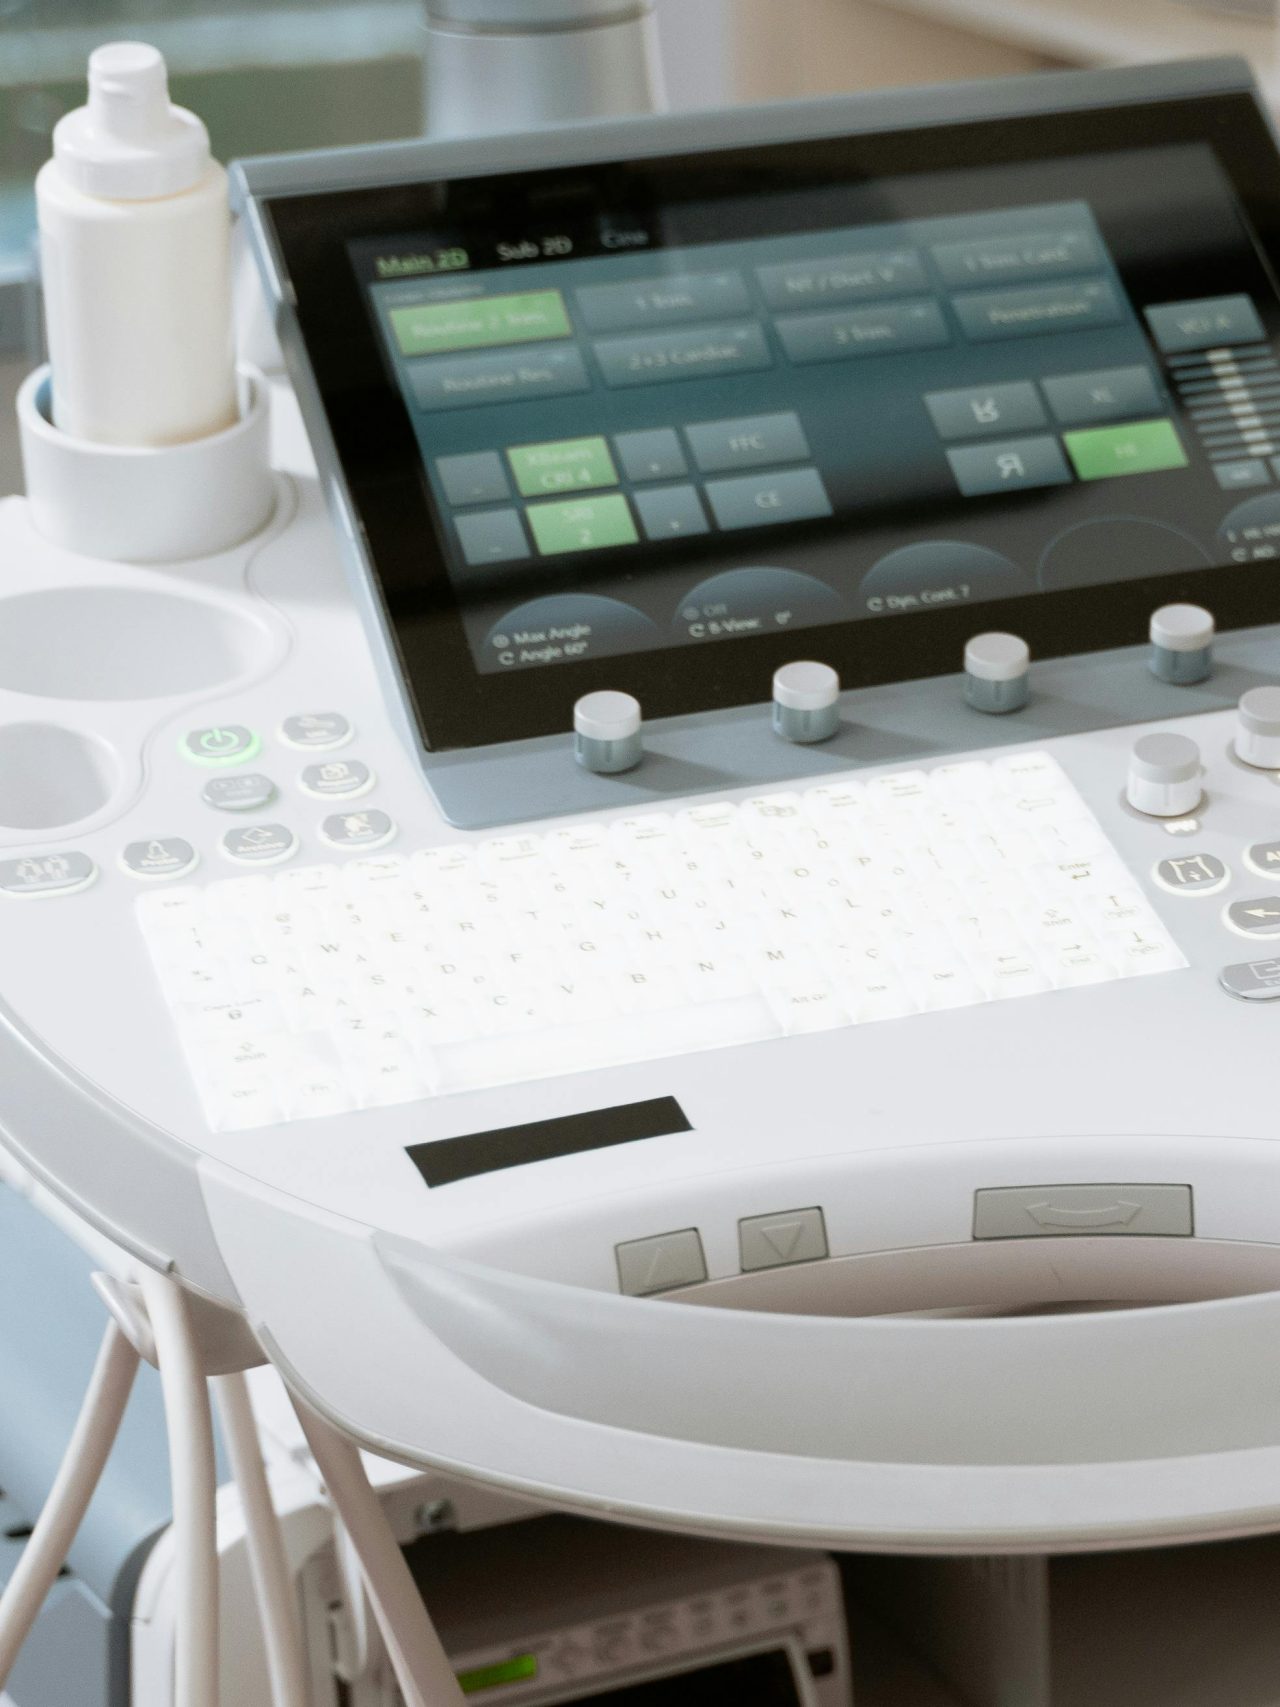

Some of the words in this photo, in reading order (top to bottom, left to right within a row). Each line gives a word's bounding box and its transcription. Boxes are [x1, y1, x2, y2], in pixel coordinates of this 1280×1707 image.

[497, 240, 539, 262] Sub
[542, 235, 574, 256] 2D
[377, 253, 433, 278] Main
[435, 247, 469, 271] 2D
[513, 630, 547, 645] Max
[548, 622, 592, 641] Angle
[519, 645, 563, 664] Angle
[793, 868, 810, 877] O
[660, 889, 676, 899] U
[320, 944, 339, 953] W
[579, 941, 596, 951] G
[250, 955, 268, 965] Q
[766, 950, 784, 960] M
[698, 962, 714, 971] N
